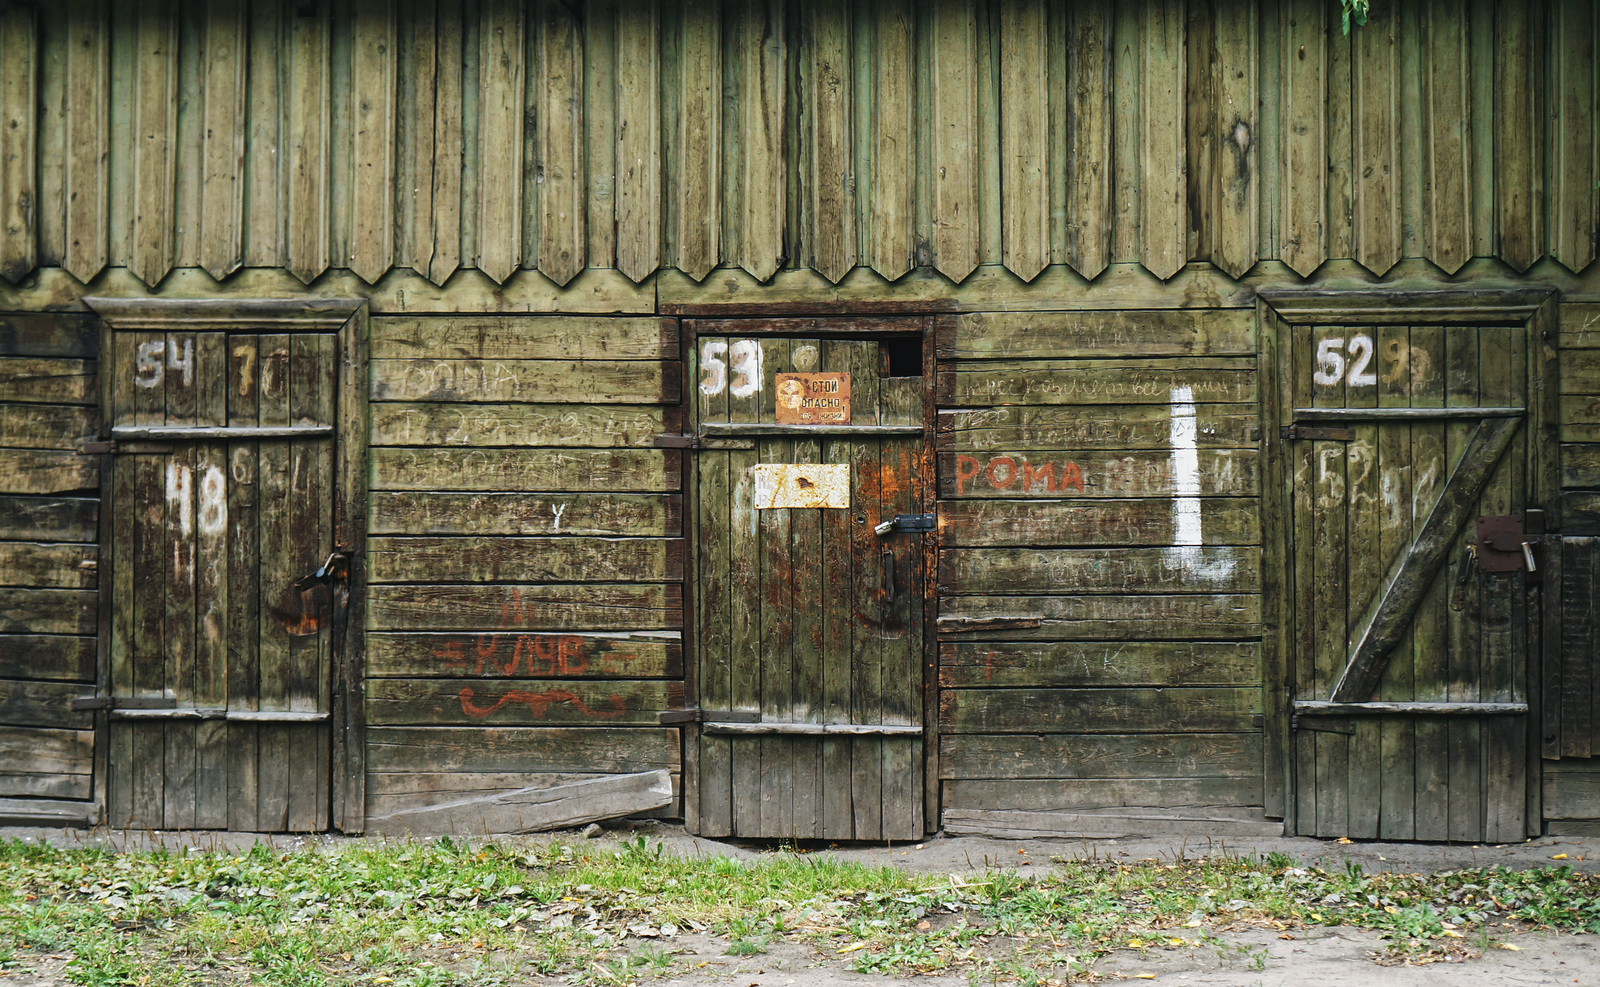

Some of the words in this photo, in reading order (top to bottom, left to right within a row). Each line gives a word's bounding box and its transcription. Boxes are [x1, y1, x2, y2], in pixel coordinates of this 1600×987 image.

[135, 338, 194, 389] 54
[699, 339, 765, 398] 53
[811, 377, 838, 393] СТОЙ
[1313, 333, 1378, 387] 52
[801, 398, 840, 408] ОПАСНО
[955, 453, 1085, 497] РОМА
[166, 463, 229, 539] 48
